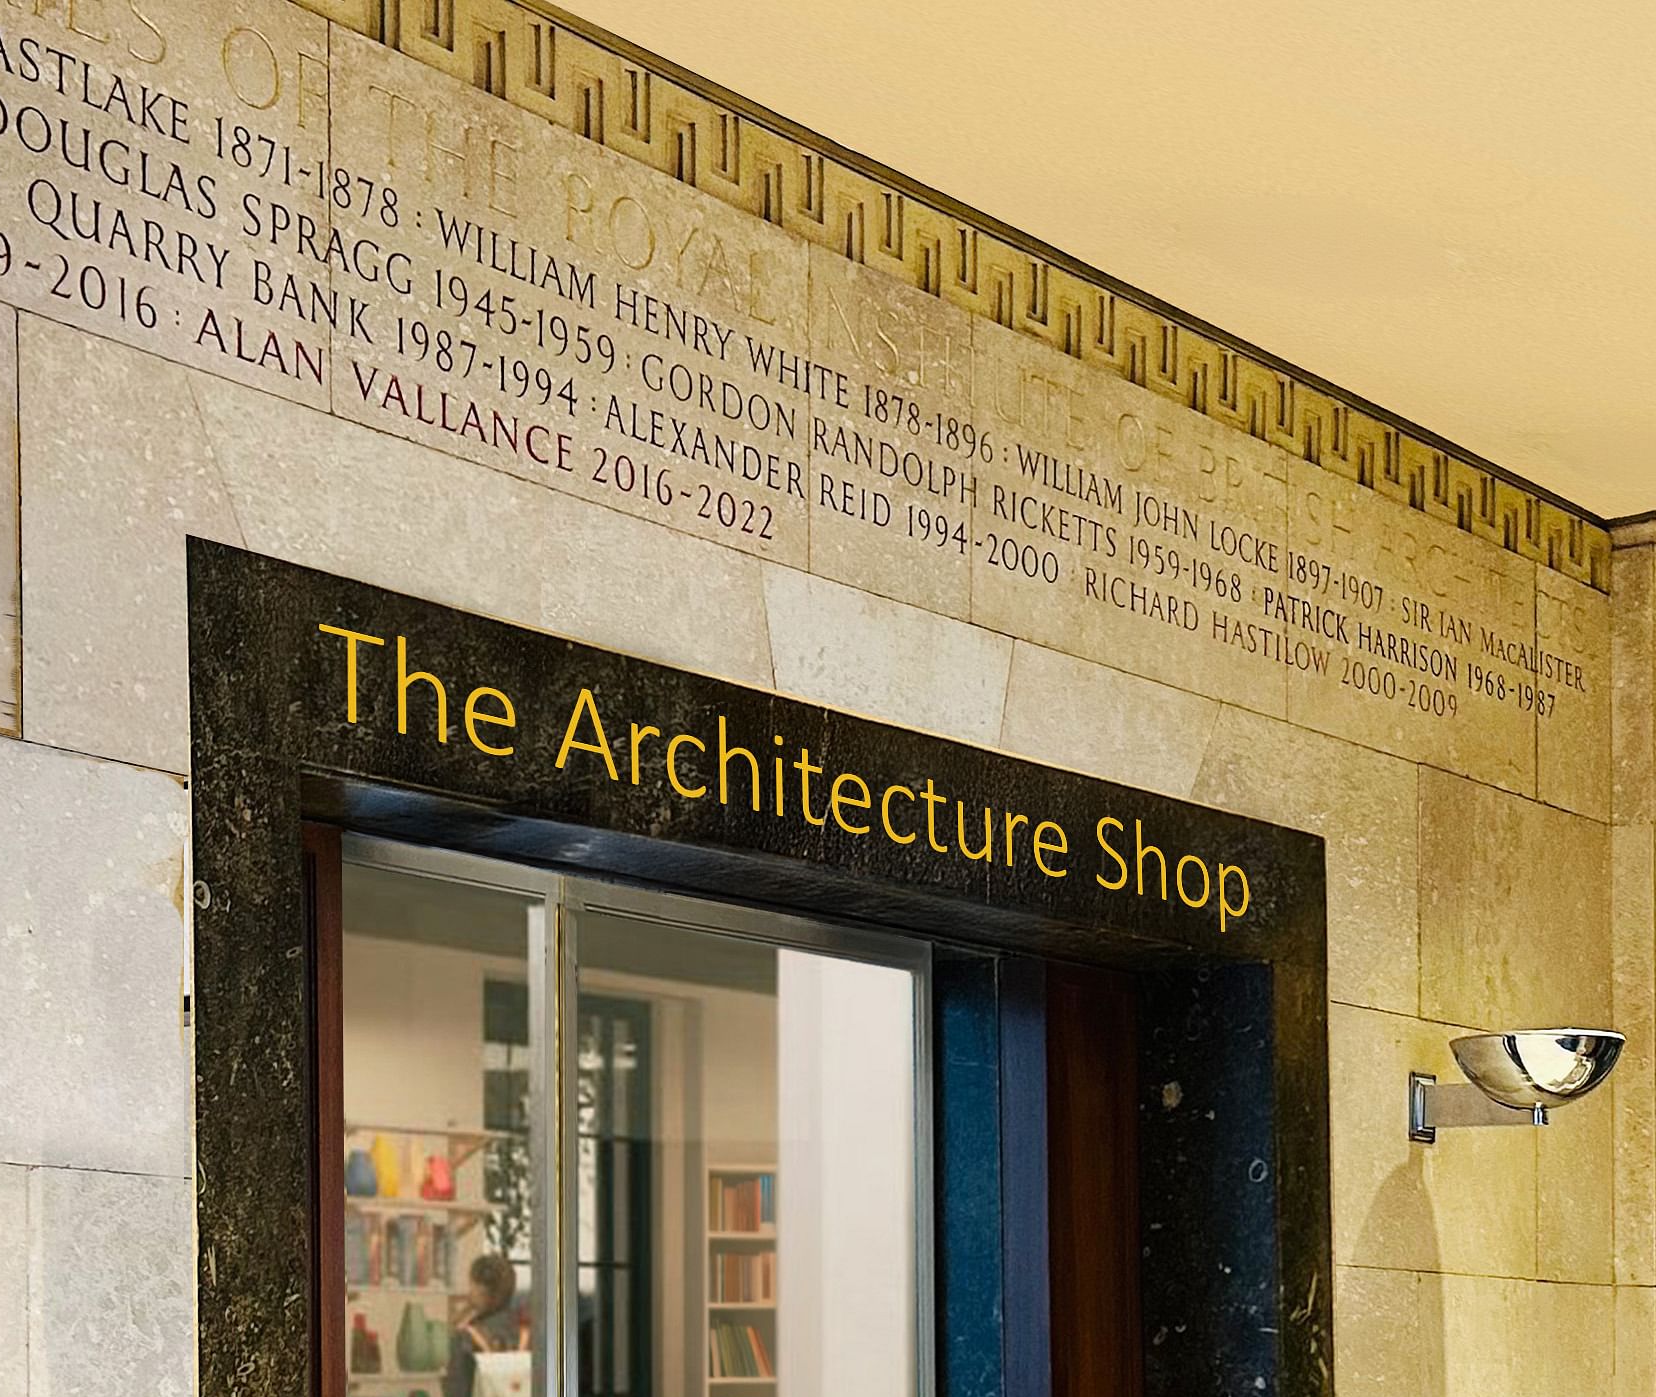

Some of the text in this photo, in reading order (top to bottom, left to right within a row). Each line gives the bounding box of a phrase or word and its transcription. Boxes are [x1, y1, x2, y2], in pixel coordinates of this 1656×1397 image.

[27, 178, 231, 289] QUARRY
[253, 259, 374, 345] BANK
[397, 316, 579, 416] 1987-1994
[604, 395, 806, 501] ALEXANDER
[819, 474, 891, 527] REID
[907, 505, 1059, 584] 1994-2000
[1084, 567, 1199, 632] RICHARD
[1212, 610, 1331, 677] HASTILOW
[1340, 657, 1459, 719] 2000-2009
[195, 308, 324, 385] ALAN
[352, 361, 573, 473] VALLANCE
[591, 447, 775, 540] 2016-2022
[214, 116, 400, 228] 1871-1878
[433, 207, 598, 310] WILLIAM
[614, 283, 737, 361] HENRY
[745, 336, 850, 409] WHITE
[863, 383, 994, 464] 1878-1896
[1016, 443, 1124, 516] WILLIAM
[1133, 490, 1199, 541] JOHN
[1209, 520, 1279, 574] LOCKE
[1287, 551, 1383, 614] 1897-1907
[1401, 595, 1432, 634] SIR
[1439, 610, 1472, 645] IAN
[243, 193, 414, 297] SPRAGG
[435, 269, 616, 375] 1945-1959
[642, 353, 796, 440] GORDON
[813, 416, 978, 509] RANDOLPH
[993, 484, 1117, 558] RICKETTS
[1129, 535, 1242, 604] 1959-1968
[1263, 586, 1350, 646] PATRICK
[1358, 621, 1457, 683] HARRISON
[1467, 662, 1556, 719] 1968-1987
[318, 621, 1250, 933] The Architecture Shop
